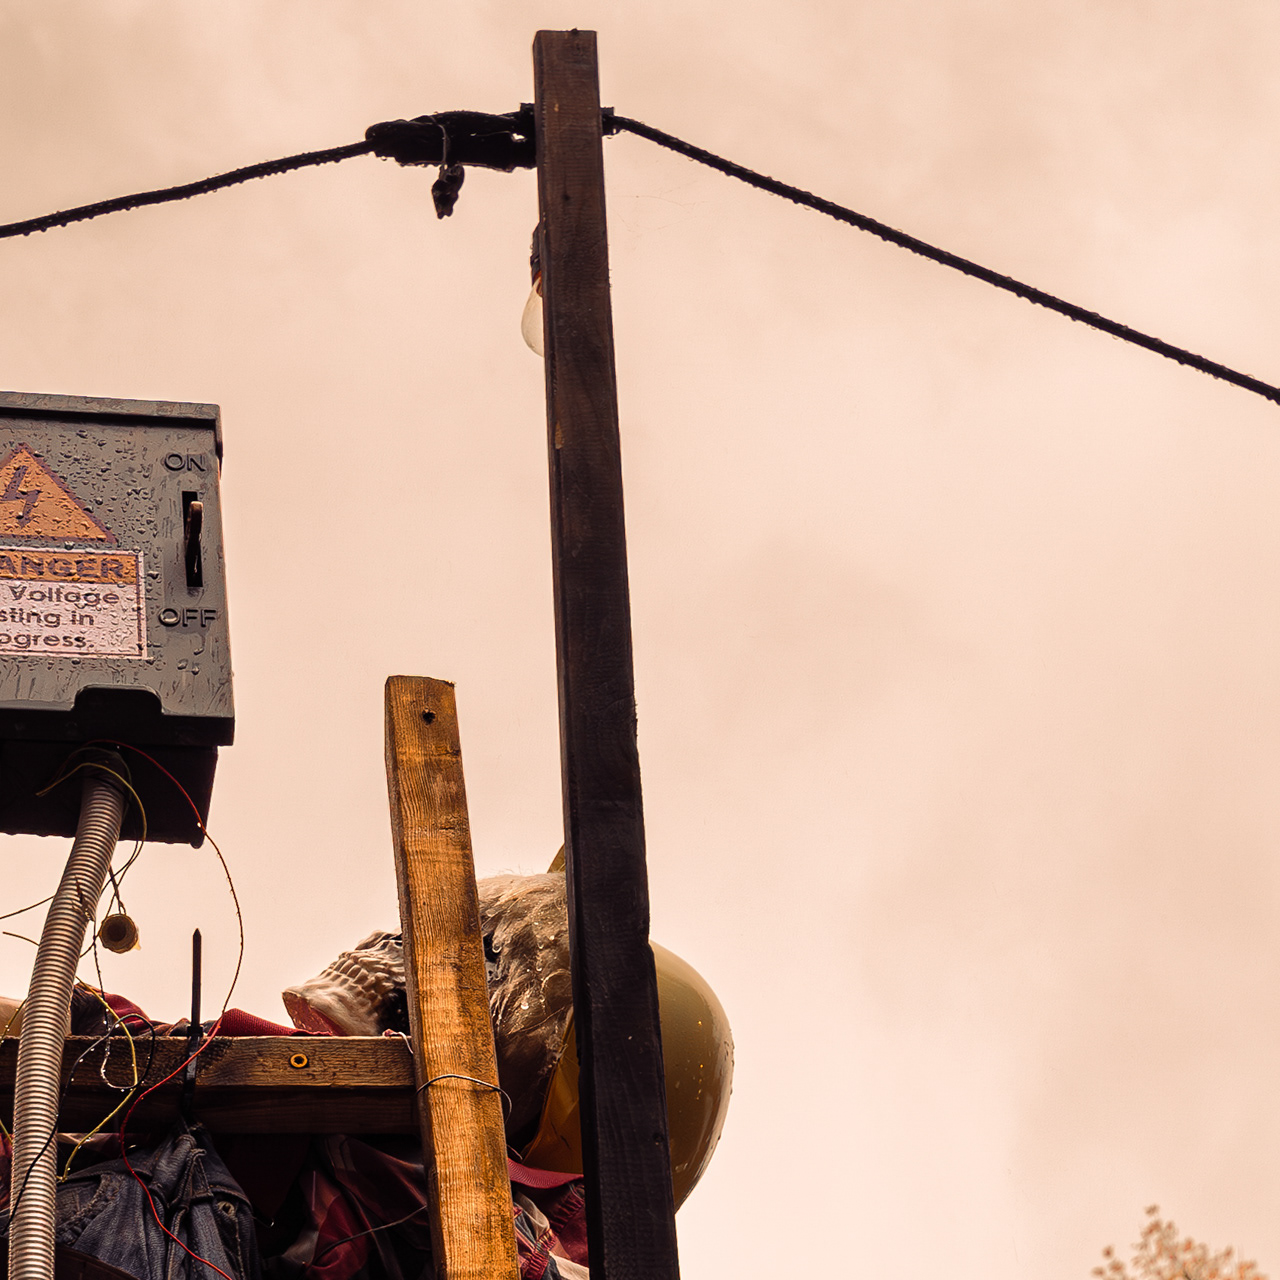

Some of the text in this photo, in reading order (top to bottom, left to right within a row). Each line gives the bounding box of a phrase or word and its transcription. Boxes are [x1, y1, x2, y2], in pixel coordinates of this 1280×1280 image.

[164, 452, 206, 472] ON
[9, 585, 120, 607] Voltage
[71, 610, 94, 626] in
[158, 608, 217, 628] OFF
